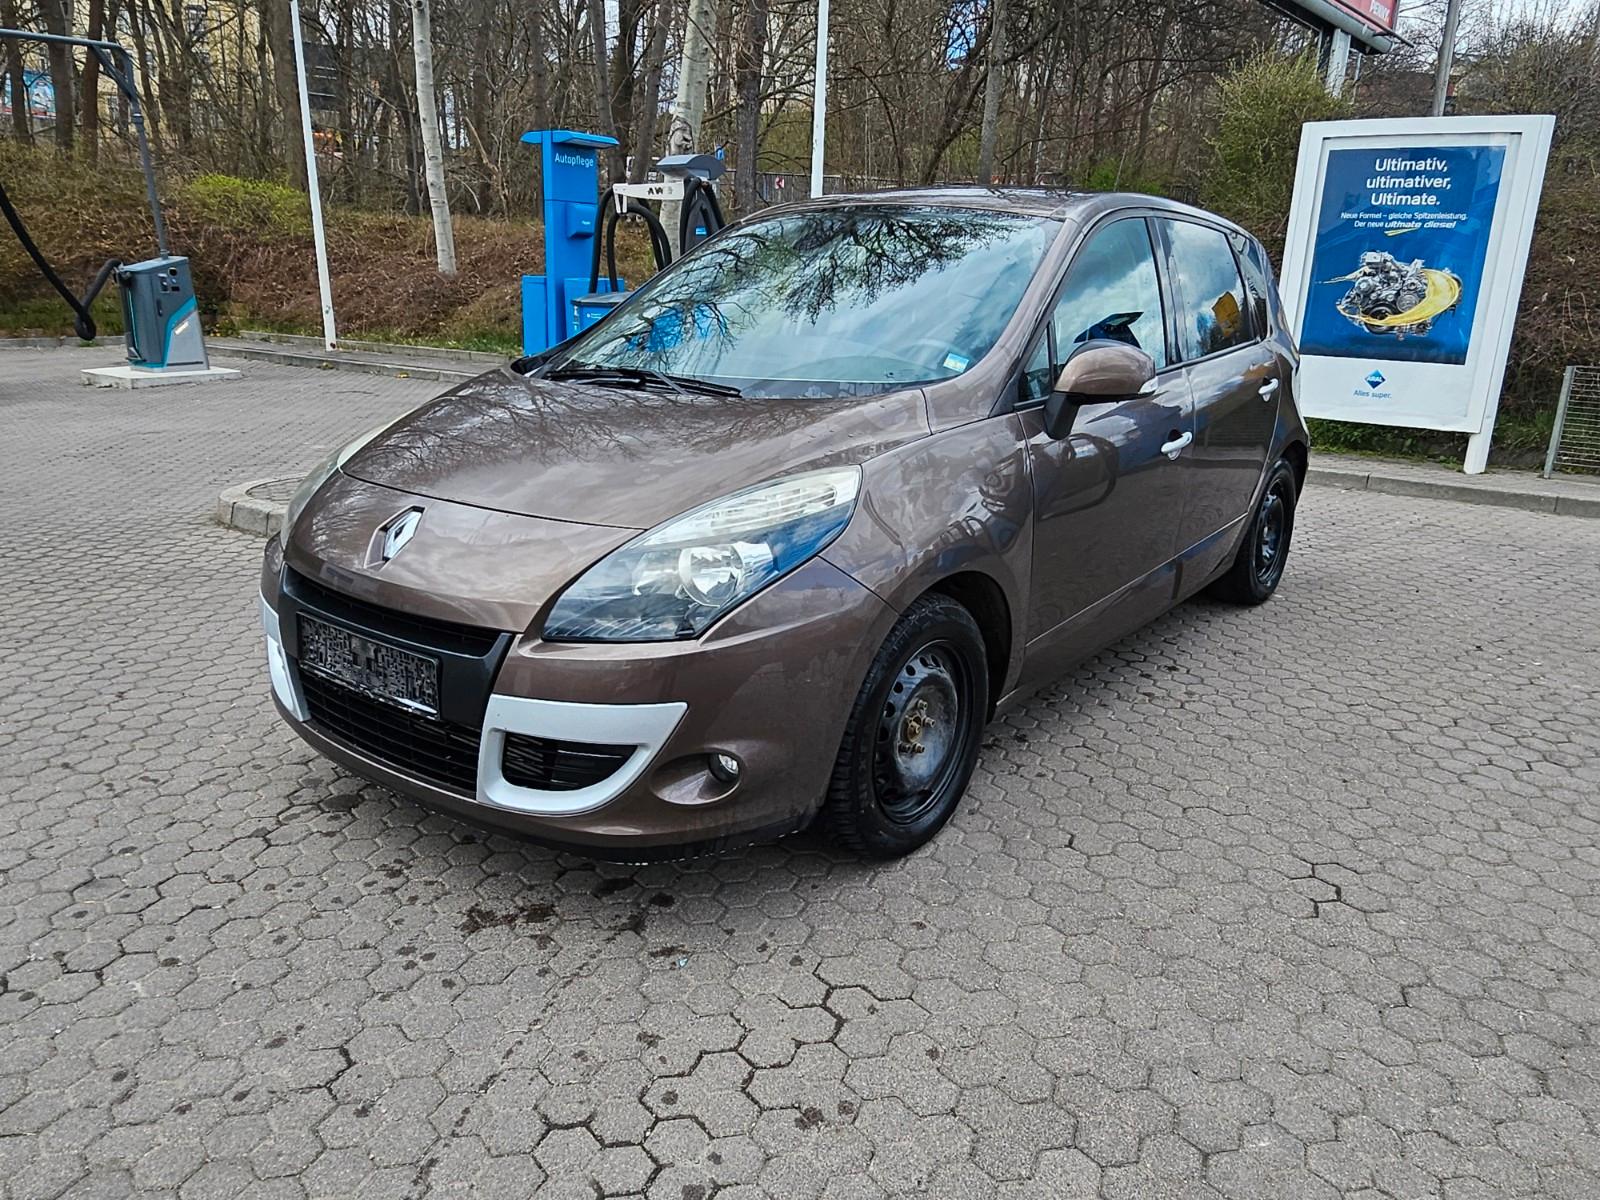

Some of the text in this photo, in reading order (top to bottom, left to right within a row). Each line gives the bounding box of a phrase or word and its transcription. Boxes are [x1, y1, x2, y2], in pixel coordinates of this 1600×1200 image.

[554, 152, 594, 168] Autopflege
[1375, 157, 1448, 172] Ultimativ,
[1366, 175, 1452, 190] ultimativer,
[1371, 192, 1440, 205] Ultimate.
[1388, 212, 1412, 220] gleiche
[1414, 212, 1468, 220] Spitzenleistung.
